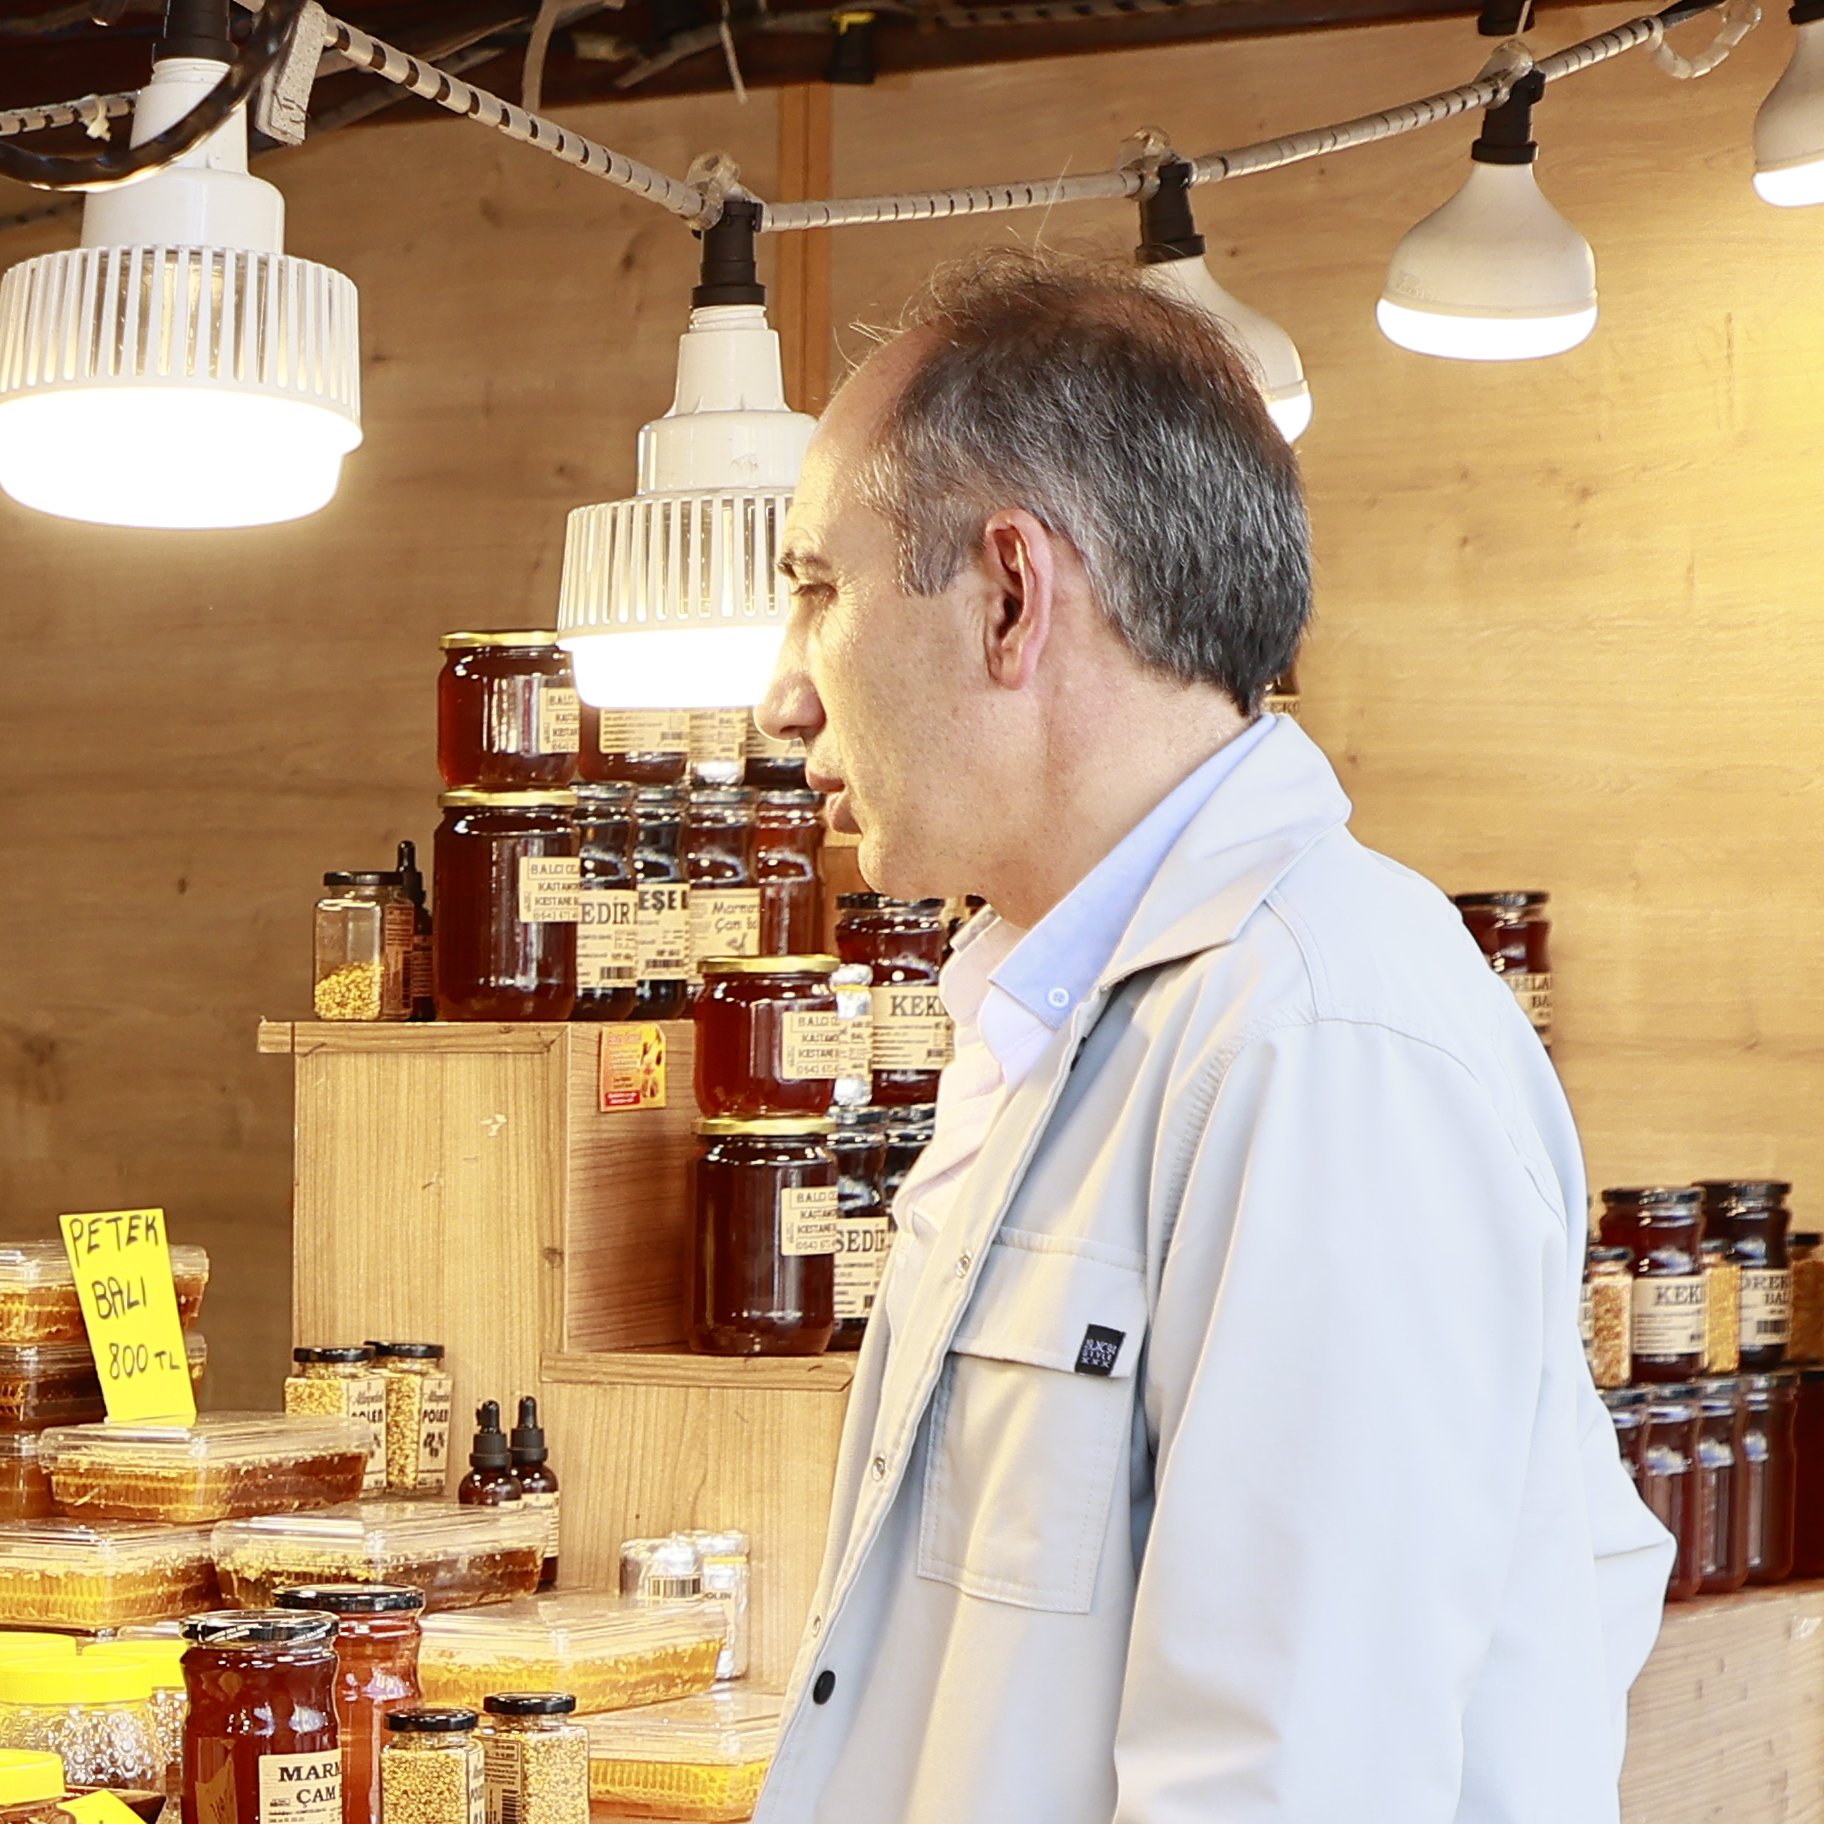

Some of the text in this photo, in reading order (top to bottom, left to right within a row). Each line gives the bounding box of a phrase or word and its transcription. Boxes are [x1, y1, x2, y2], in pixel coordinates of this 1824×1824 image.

[69, 1214, 160, 1268] PETEK
[91, 1276, 147, 1320] BALI
[108, 1342, 181, 1380] 800 TL
[296, 1785, 336, 1808] ÇAM
